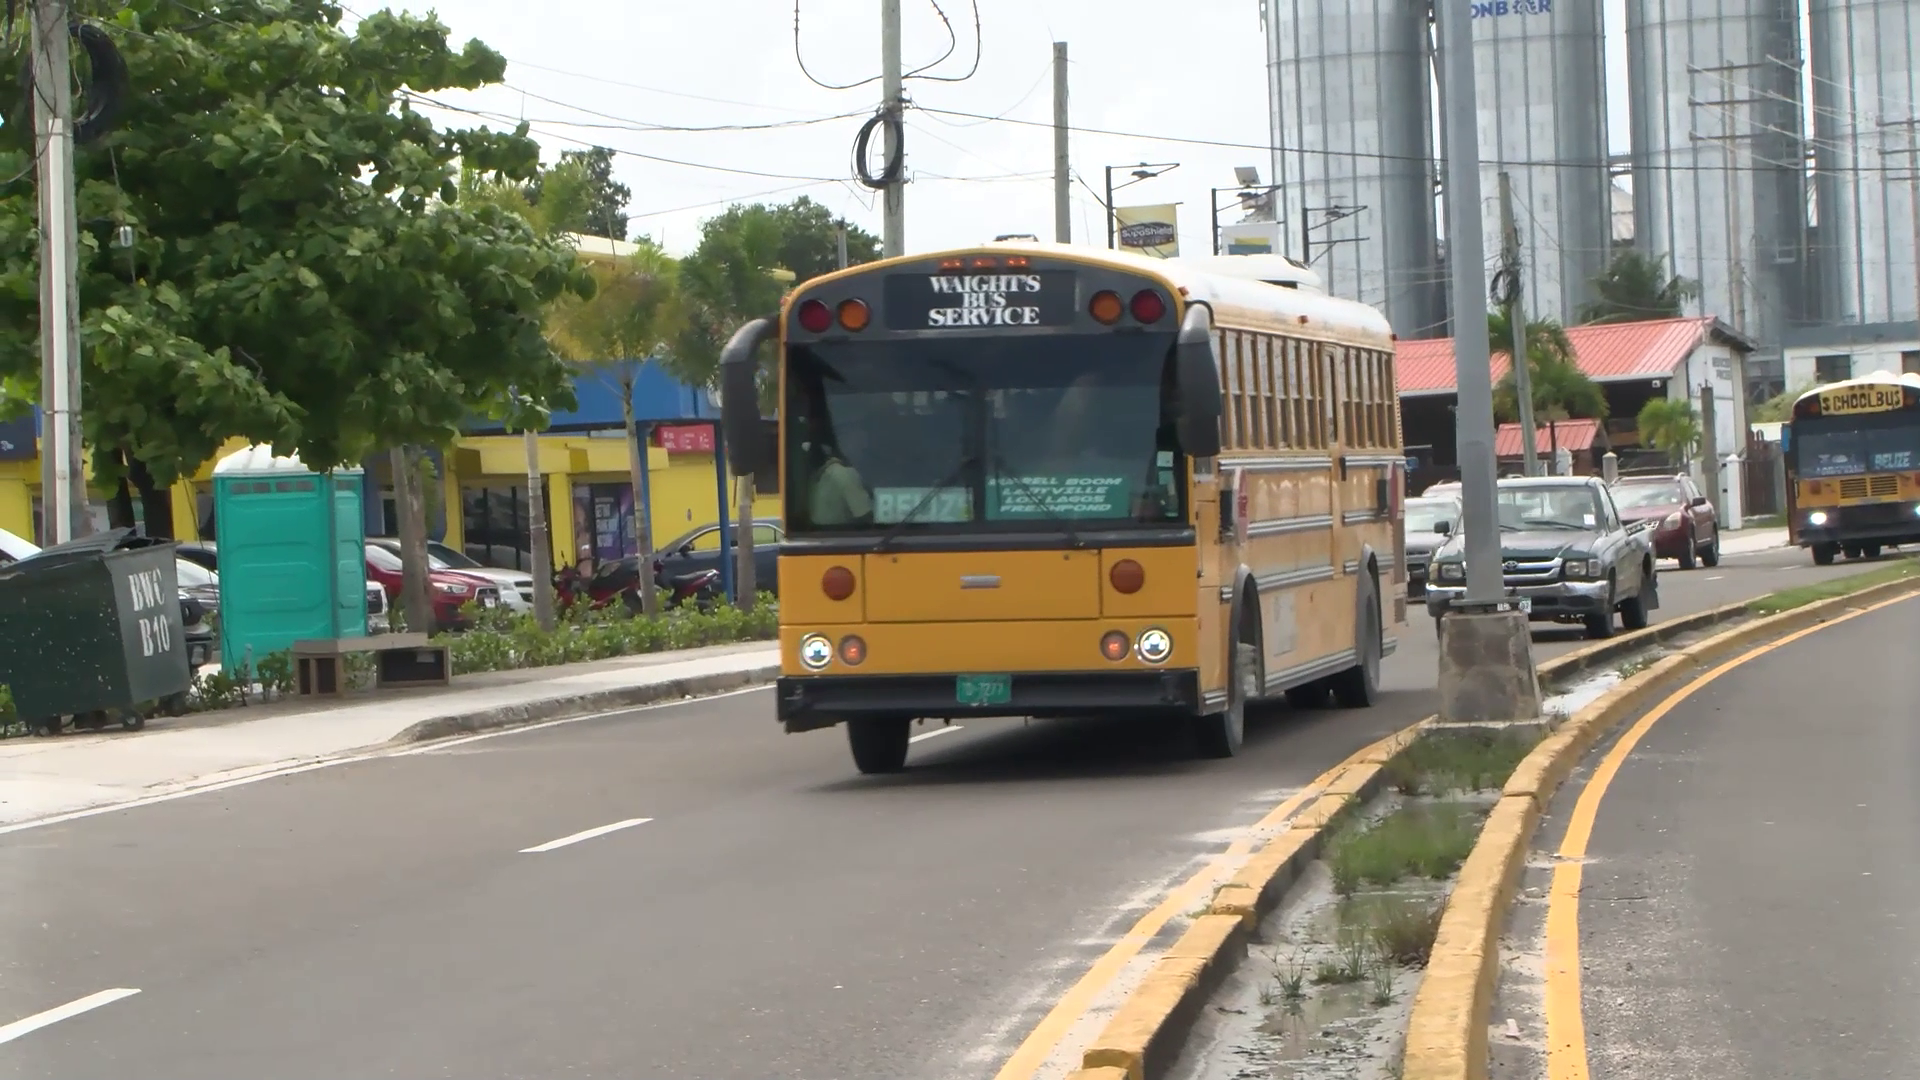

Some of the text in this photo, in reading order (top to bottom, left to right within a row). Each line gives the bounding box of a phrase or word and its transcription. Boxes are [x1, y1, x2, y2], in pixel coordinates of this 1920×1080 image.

[928, 274, 1041, 293] WAIGHT'S
[962, 292, 1007, 308] BUS
[928, 306, 1040, 326] SERVICE
[1065, 477, 1123, 486] BOOM
[1044, 495, 1106, 504] LAGOS
[128, 566, 165, 611] BWC
[139, 614, 170, 656] B10
